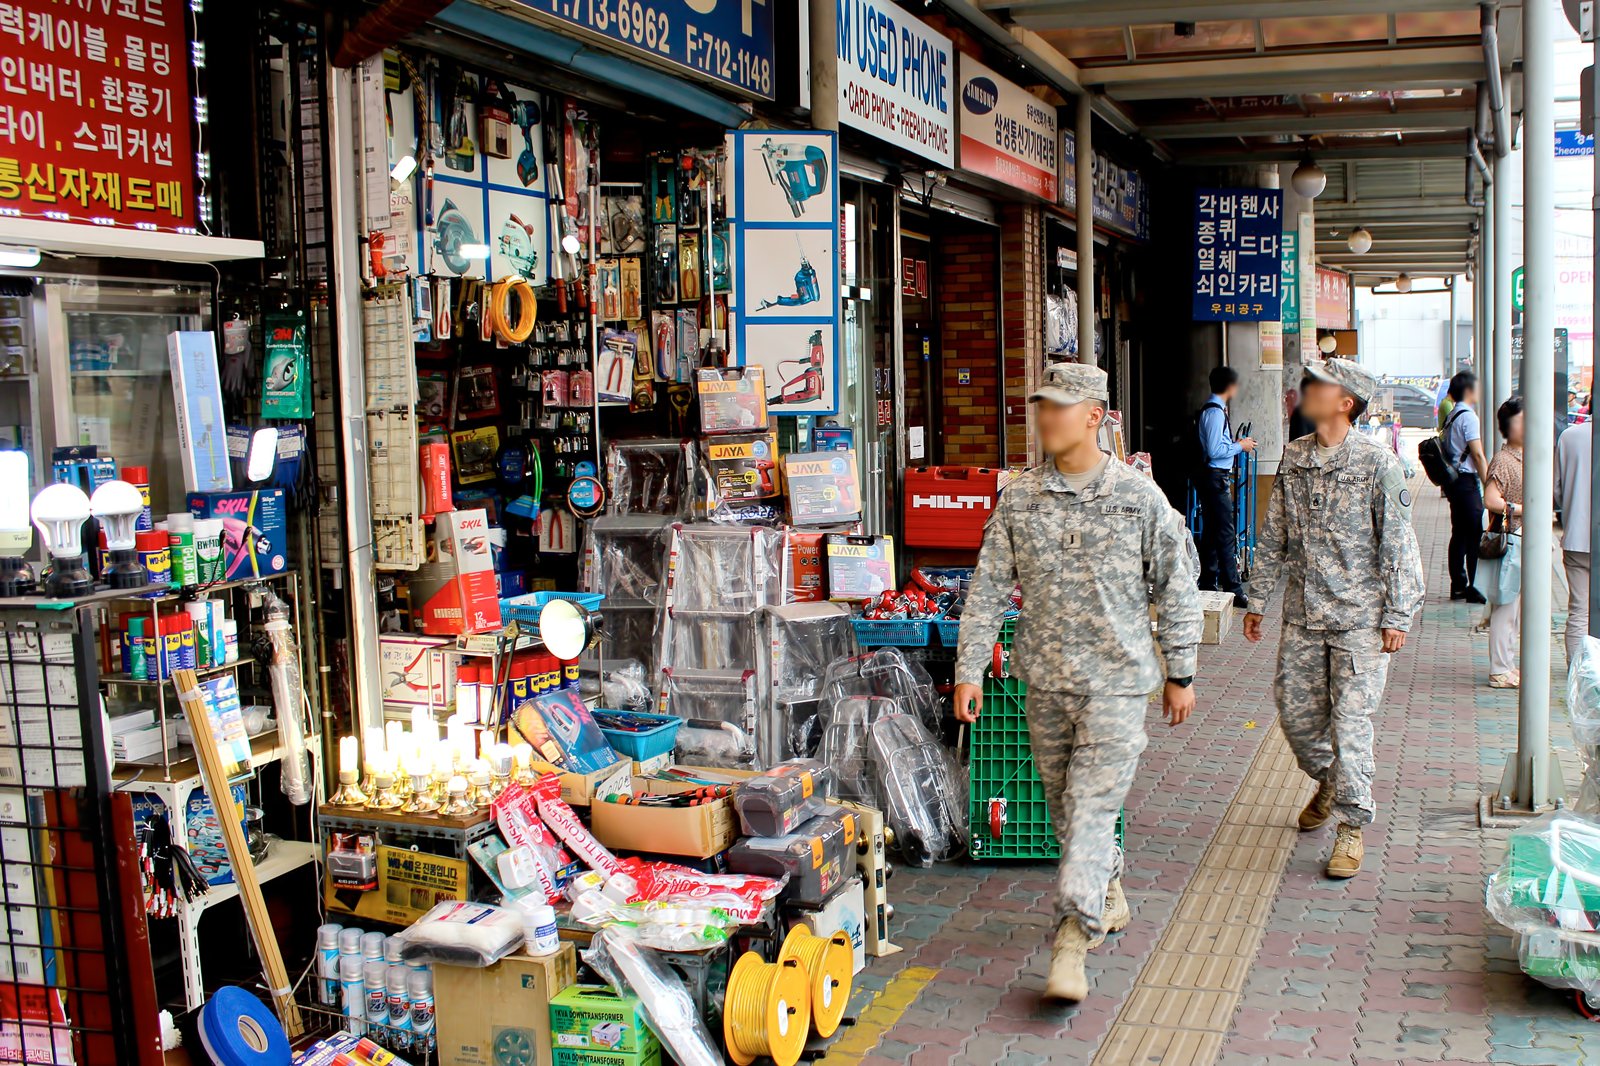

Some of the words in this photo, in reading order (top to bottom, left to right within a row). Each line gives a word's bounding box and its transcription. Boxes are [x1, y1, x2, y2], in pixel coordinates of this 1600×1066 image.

[855, 0, 898, 87] USED
[902, 27, 947, 114] PHONE
[102, 76, 172, 123] 환풍기
[966, 81, 995, 109] SAMSUNG
[848, 81, 870, 119] CARD
[871, 93, 895, 130] PHONE
[901, 107, 926, 144] PREPAID
[928, 121, 948, 154] PHONE
[73, 122, 173, 166] 스피커선
[995, 113, 1055, 169] 삼성통신기기대리점
[1197, 195, 1217, 297] 각종열쇠
[1239, 195, 1258, 297] 핸드카
[1260, 196, 1279, 298] 사다리
[1211, 303, 1264, 315] 우리공구
[273, 328, 292, 340] 3M
[703, 382, 731, 392] JAYA
[715, 446, 745, 458] JAYA
[792, 463, 823, 475] JAYA
[214, 497, 249, 515] SKIL
[912, 494, 991, 510] HILTI
[1026, 503, 1041, 511] LEE
[1121, 507, 1142, 515] ARMY
[460, 519, 482, 530] SKIL
[797, 544, 819, 555] Power
[832, 546, 862, 556] JAYA
[474, 611, 485, 621] 12
[167, 636, 180, 645] D-40
[584, 840, 619, 877] MULTI
[369, 1002, 386, 1010] 747
[414, 1012, 430, 1020] 747
[555, 1009, 568, 1018] 1KVA
[557, 1052, 571, 1060] 1KVA
